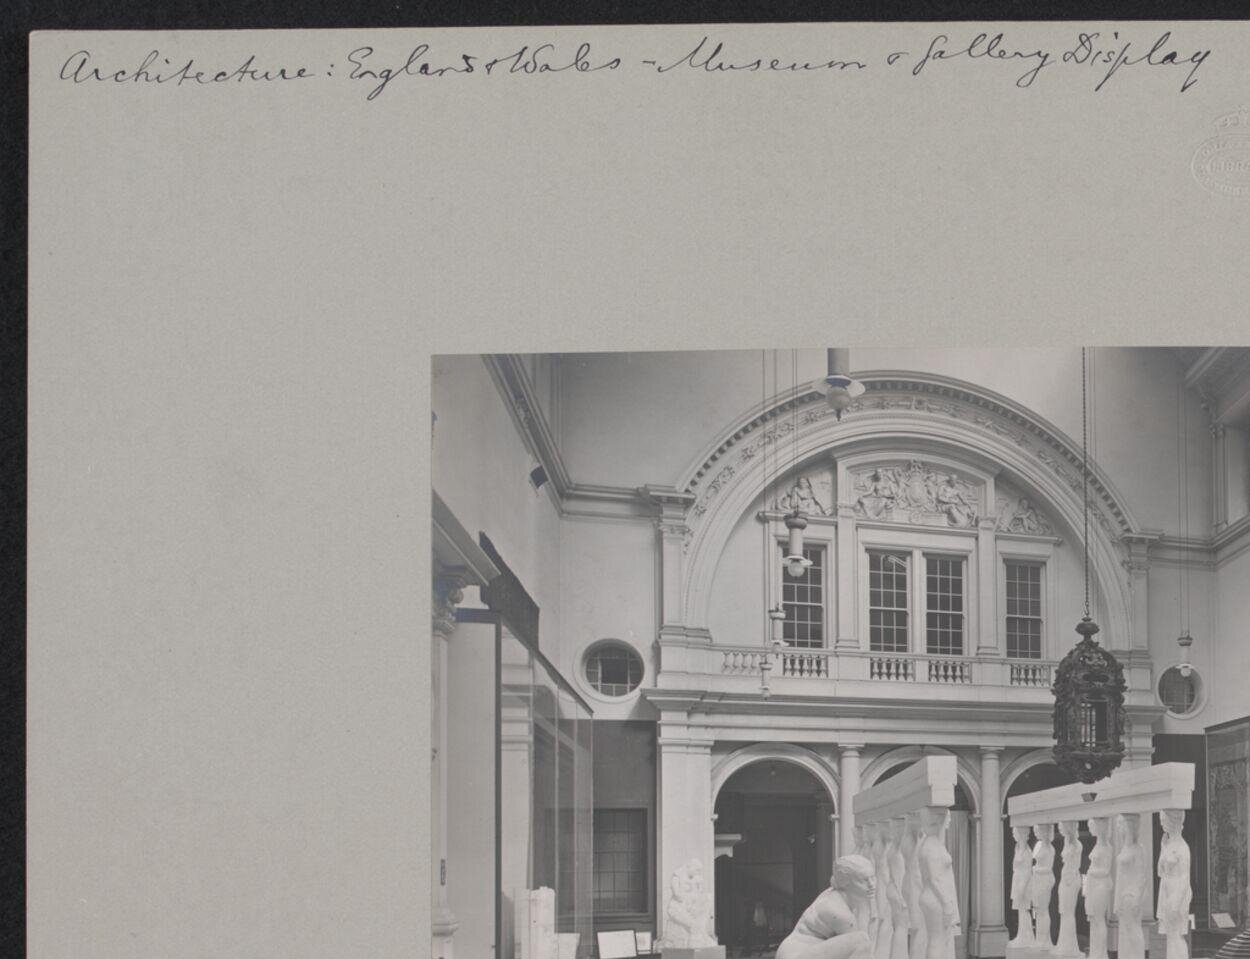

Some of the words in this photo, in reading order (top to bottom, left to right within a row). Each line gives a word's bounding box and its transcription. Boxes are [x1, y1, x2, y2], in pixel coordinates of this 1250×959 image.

[348, 43, 478, 101] England
[497, 43, 622, 75] Wales
[657, 36, 867, 73] Museum
[912, 32, 1051, 88] Gallery
[1062, 32, 1212, 93] Display
